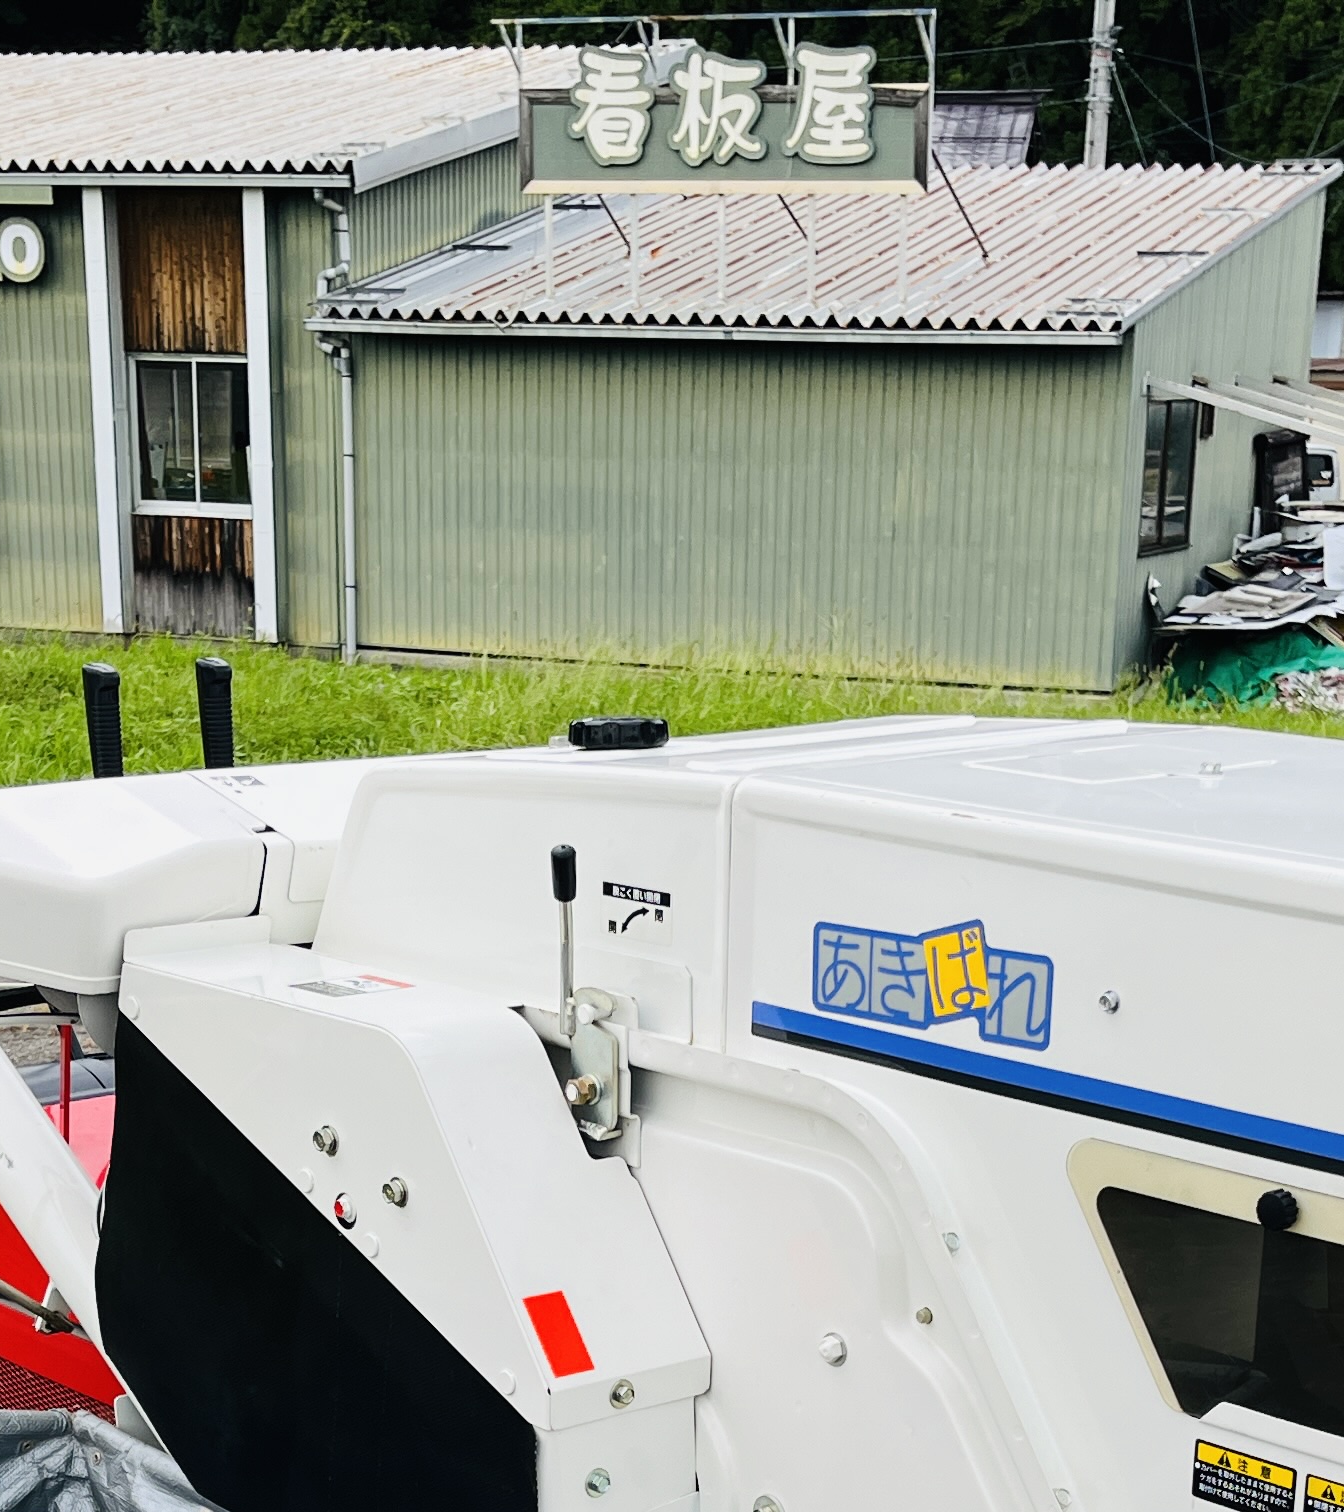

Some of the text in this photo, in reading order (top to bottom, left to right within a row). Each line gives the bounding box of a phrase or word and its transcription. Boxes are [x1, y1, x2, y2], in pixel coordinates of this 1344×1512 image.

[571, 48, 871, 160] 看板屋
[816, 922, 1050, 1046] あきばれ
[1237, 1457, 1272, 1480] 注意
